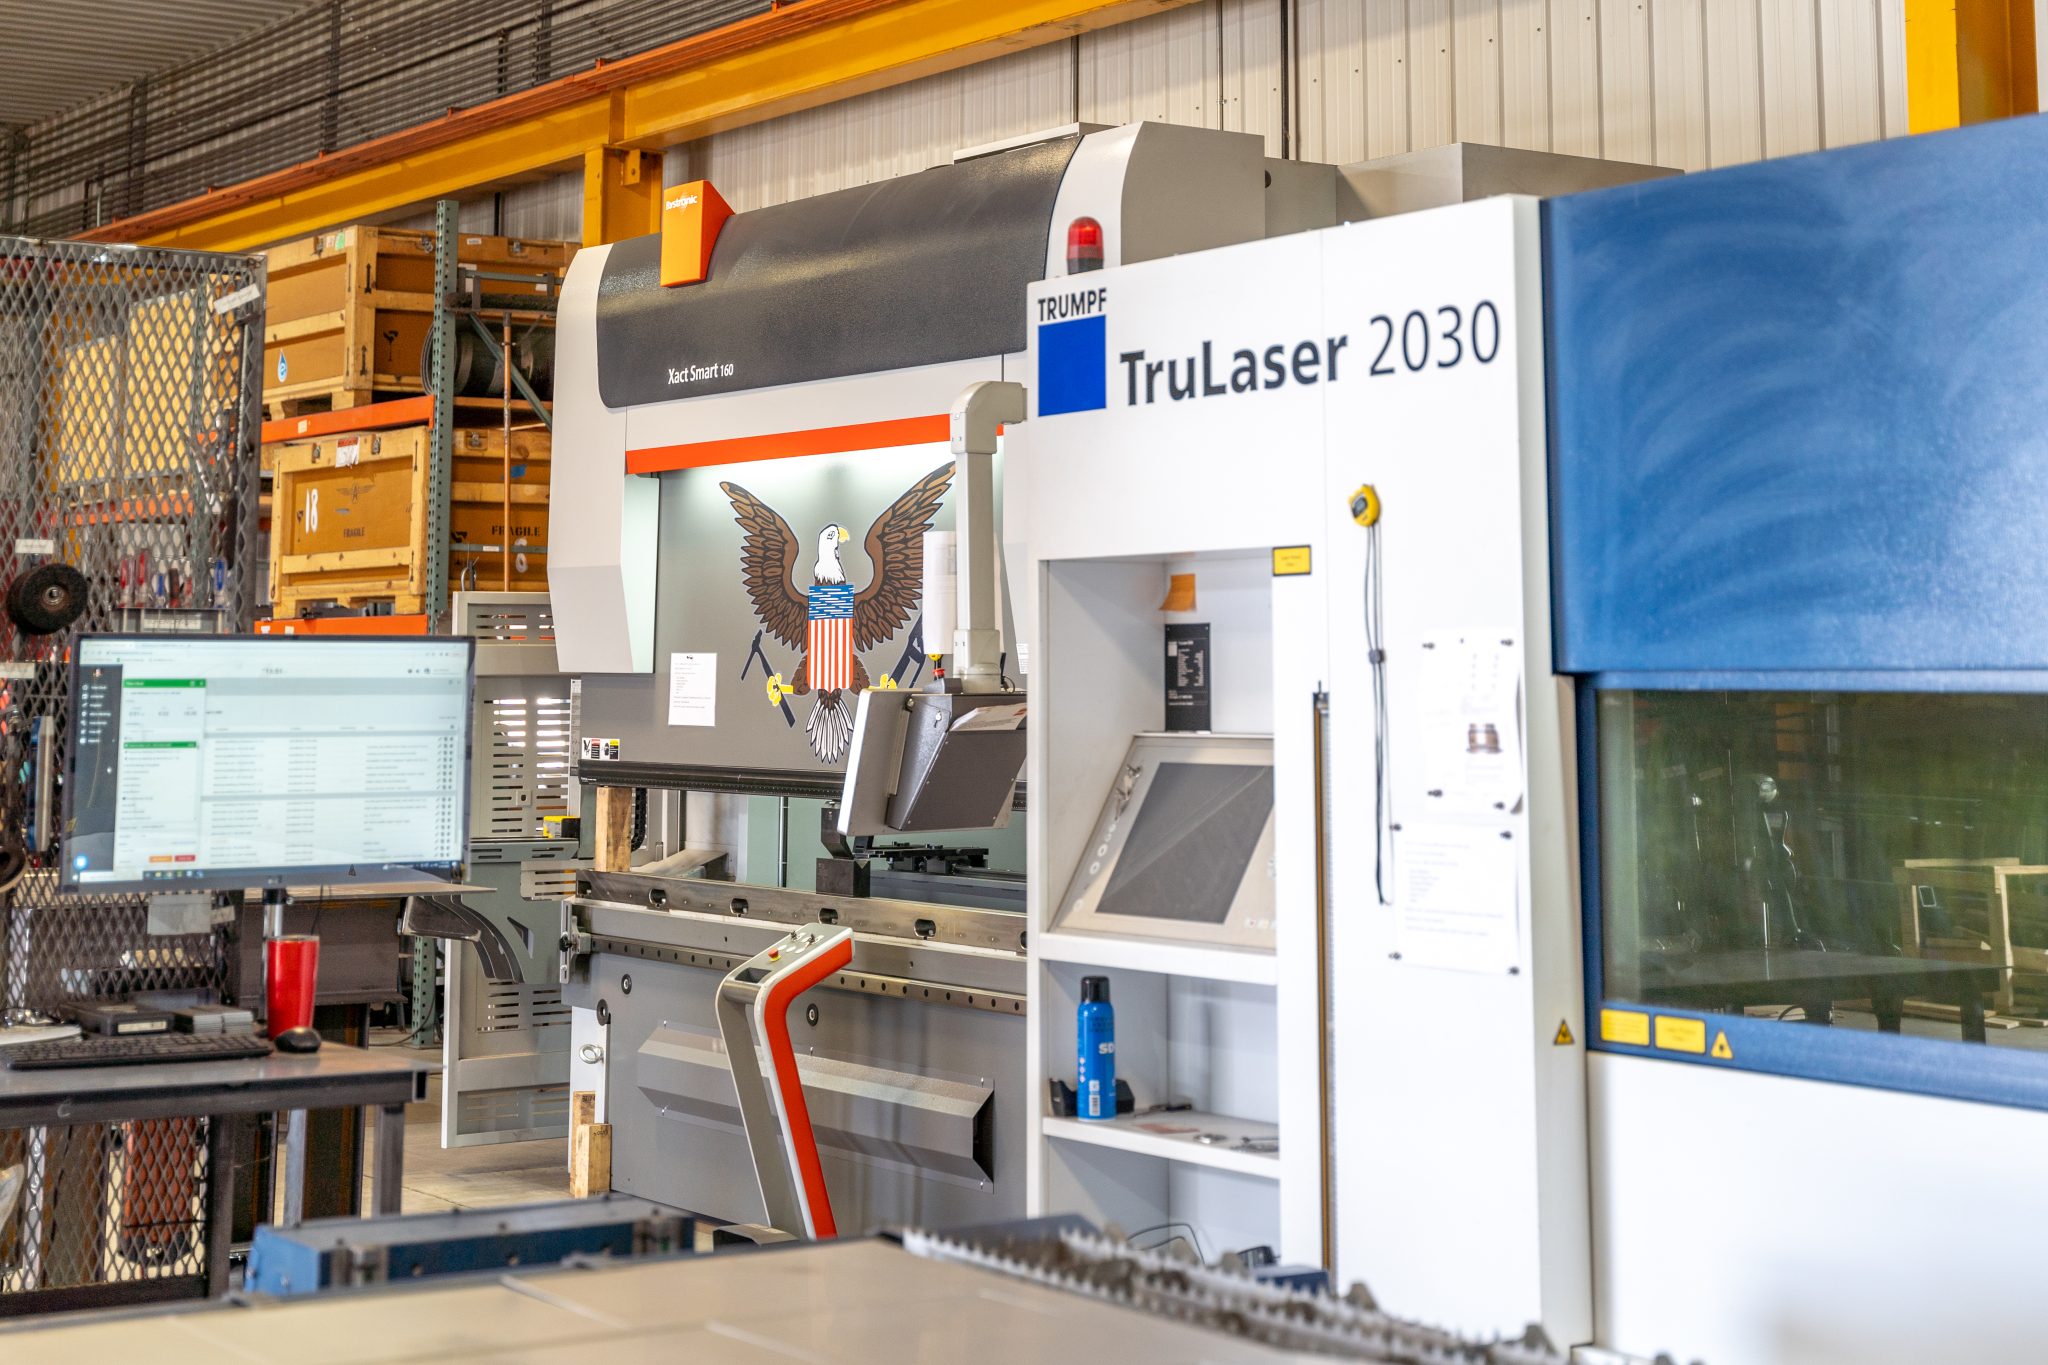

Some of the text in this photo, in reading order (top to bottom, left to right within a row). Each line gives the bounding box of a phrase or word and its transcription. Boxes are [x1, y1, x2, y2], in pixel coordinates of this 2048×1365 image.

[1038, 287, 1107, 322] TRUMPF
[1120, 299, 1500, 407] TruLaser 2030
[668, 363, 734, 385] Xact Smart 160
[344, 527, 366, 537] FRAGILE
